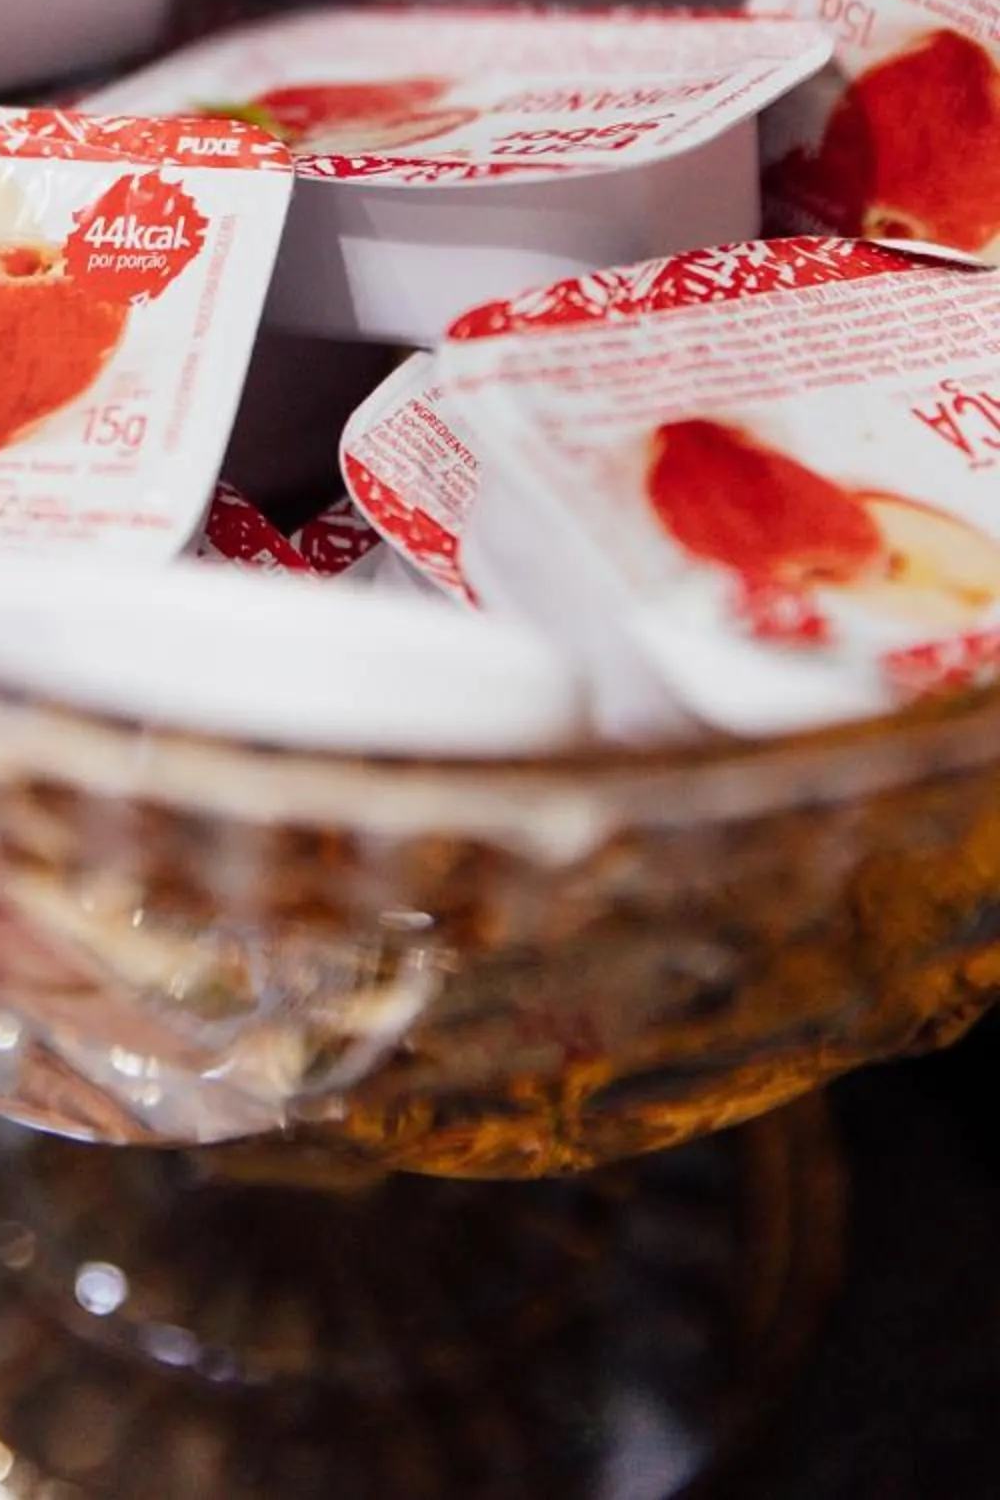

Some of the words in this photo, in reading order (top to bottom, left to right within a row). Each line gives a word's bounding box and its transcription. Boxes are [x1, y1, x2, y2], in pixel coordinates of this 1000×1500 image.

[177, 136, 242, 157] PUXE
[85, 215, 187, 250] 44kcal
[87, 254, 114, 271] por
[115, 253, 166, 271] porção
[82, 405, 148, 456] 15g
